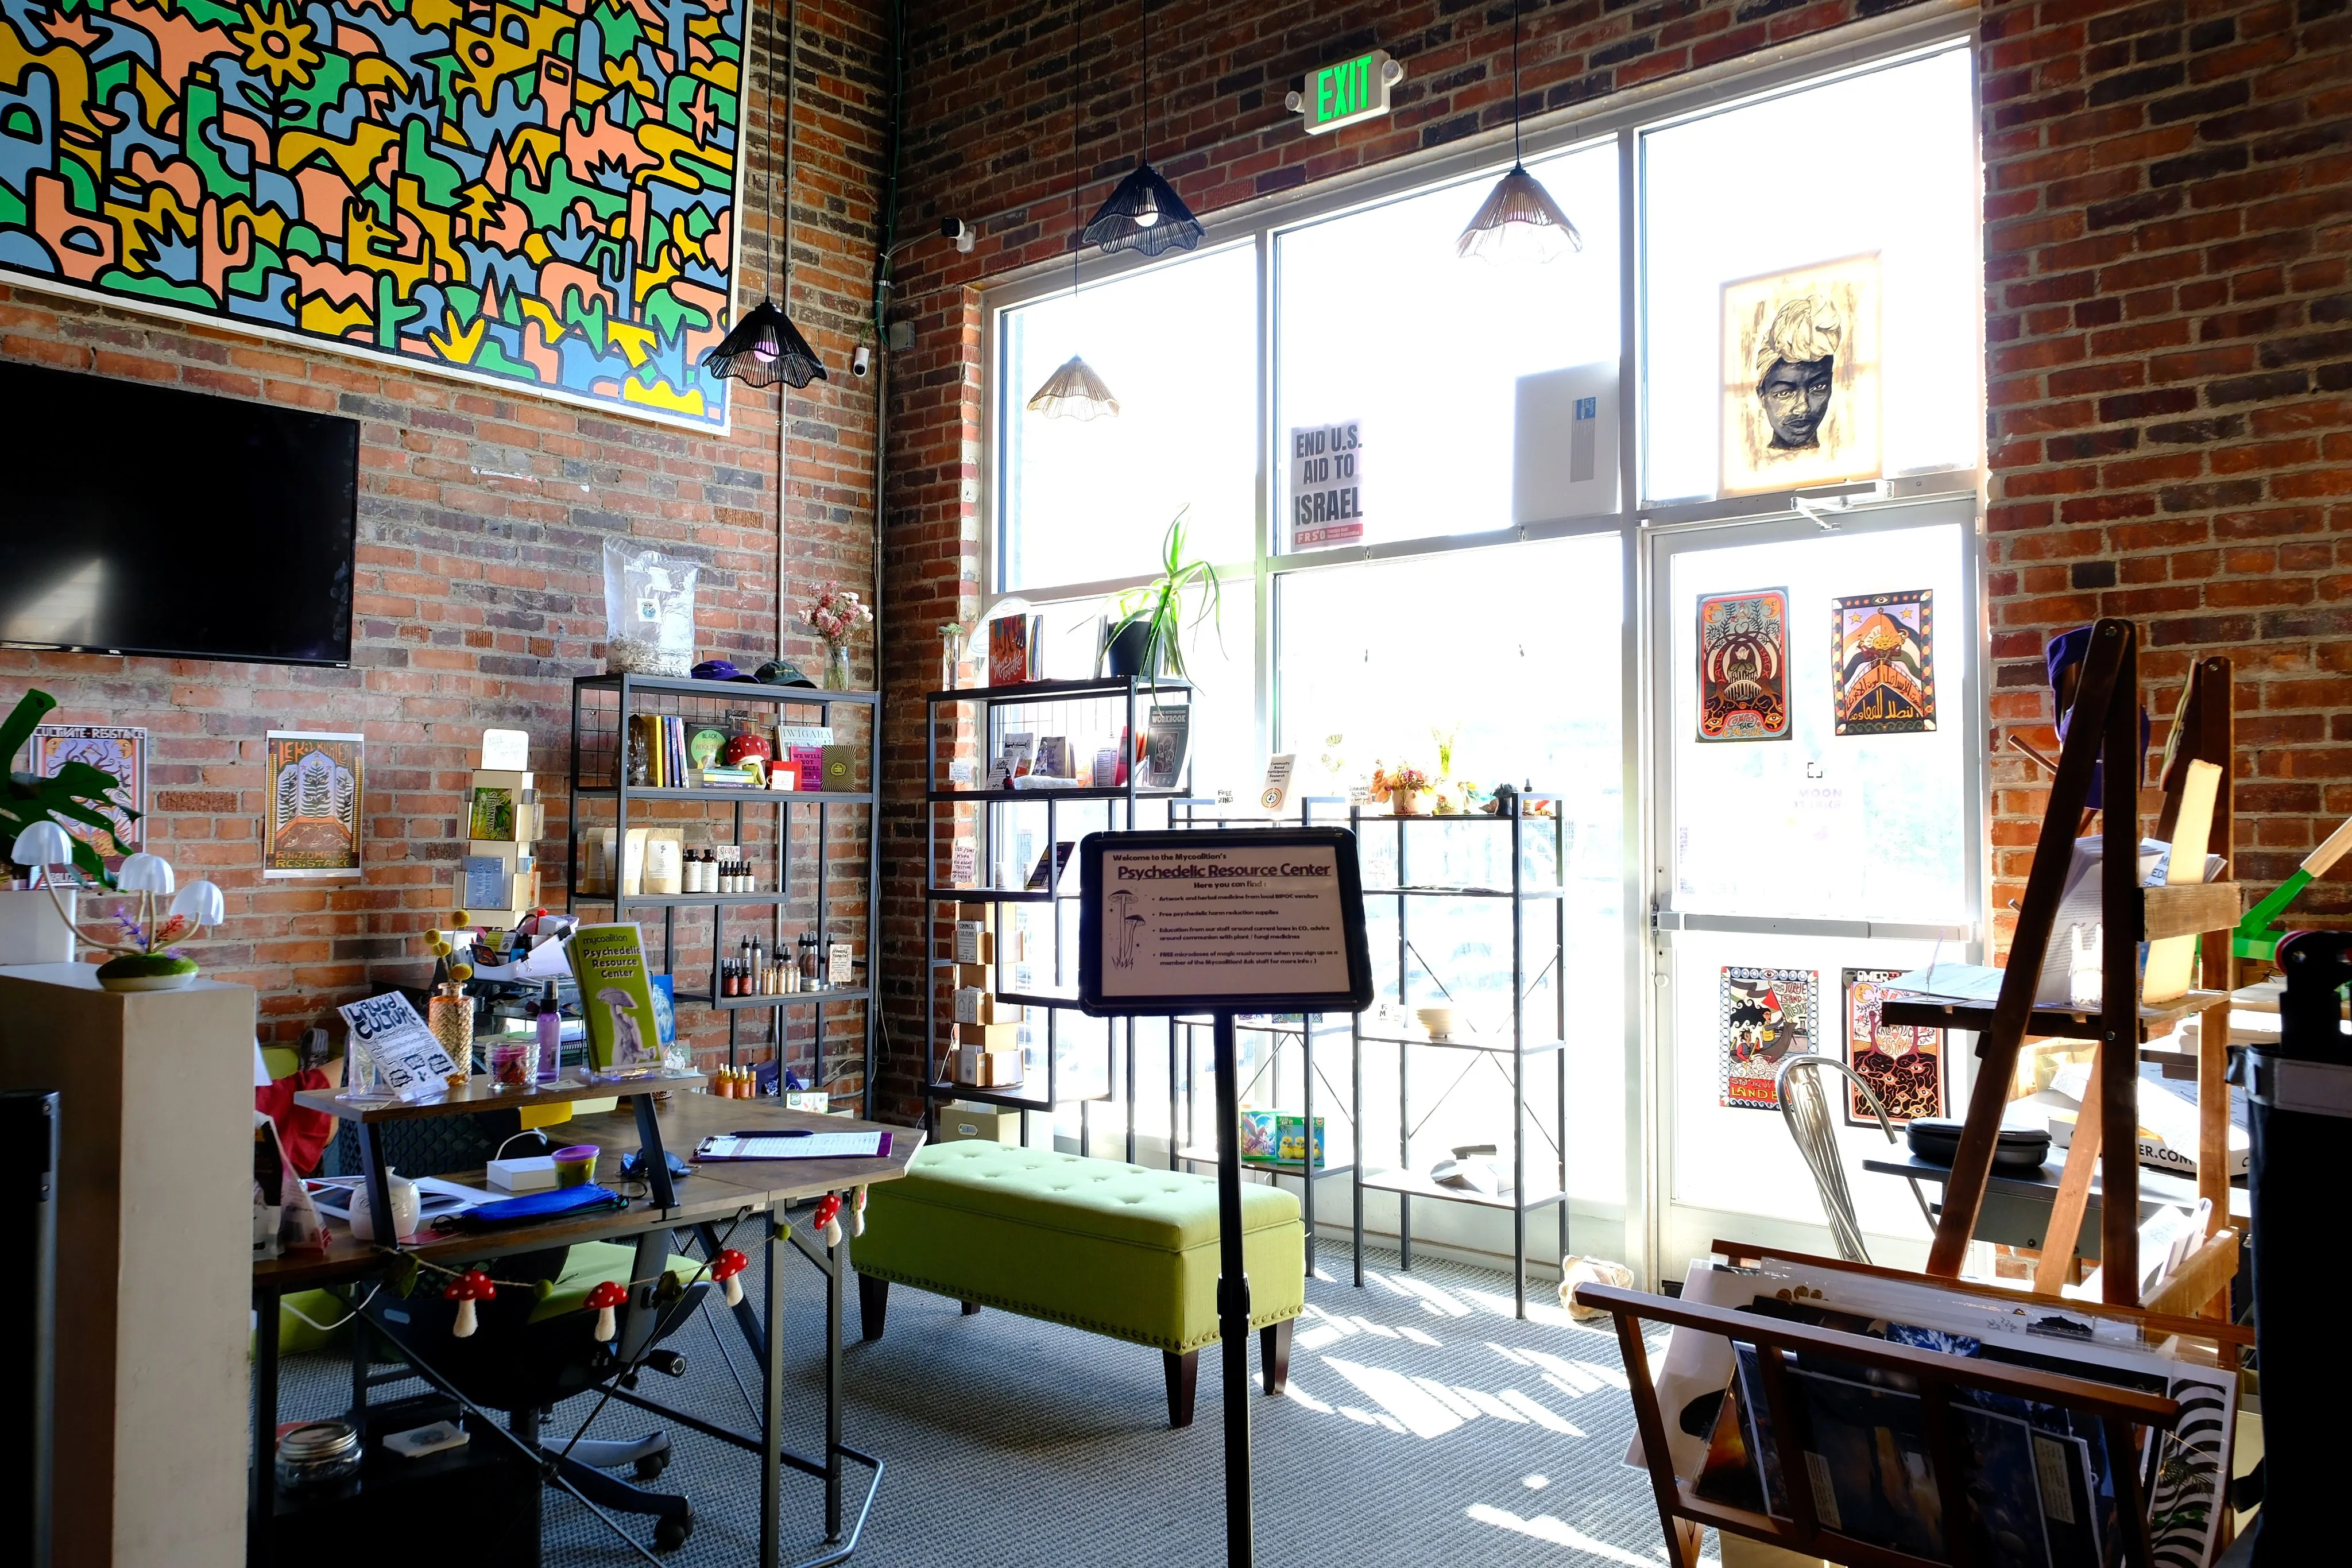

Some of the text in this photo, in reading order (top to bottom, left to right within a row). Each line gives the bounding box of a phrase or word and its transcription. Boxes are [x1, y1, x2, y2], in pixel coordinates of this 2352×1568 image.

[1318, 55, 1372, 122] EXIT
[1296, 425, 1362, 458] END U.S.
[1303, 453, 1354, 485] AID TO
[1295, 487, 1363, 526] ISRAEL
[990, 652, 998, 669] We
[1001, 650, 1023, 680] Together
[994, 656, 1008, 679] More
[1152, 715, 1186, 723] WORKBOOK
[34, 726, 144, 738] CULTIVATE RESISTANCE
[783, 727, 831, 738] IWÍGARA
[483, 791, 500, 835] CANNABIS
[275, 859, 350, 868] RESISTANCE
[1175, 853, 1227, 862] Mycoalition's
[1118, 863, 1330, 881] Psychedelic Resource Center
[583, 934, 628, 945] mycoalition
[583, 946, 641, 959] Psychedelic
[591, 958, 638, 969] Resource
[601, 969, 634, 978] Center
[1731, 1086, 1769, 1099] LAND
